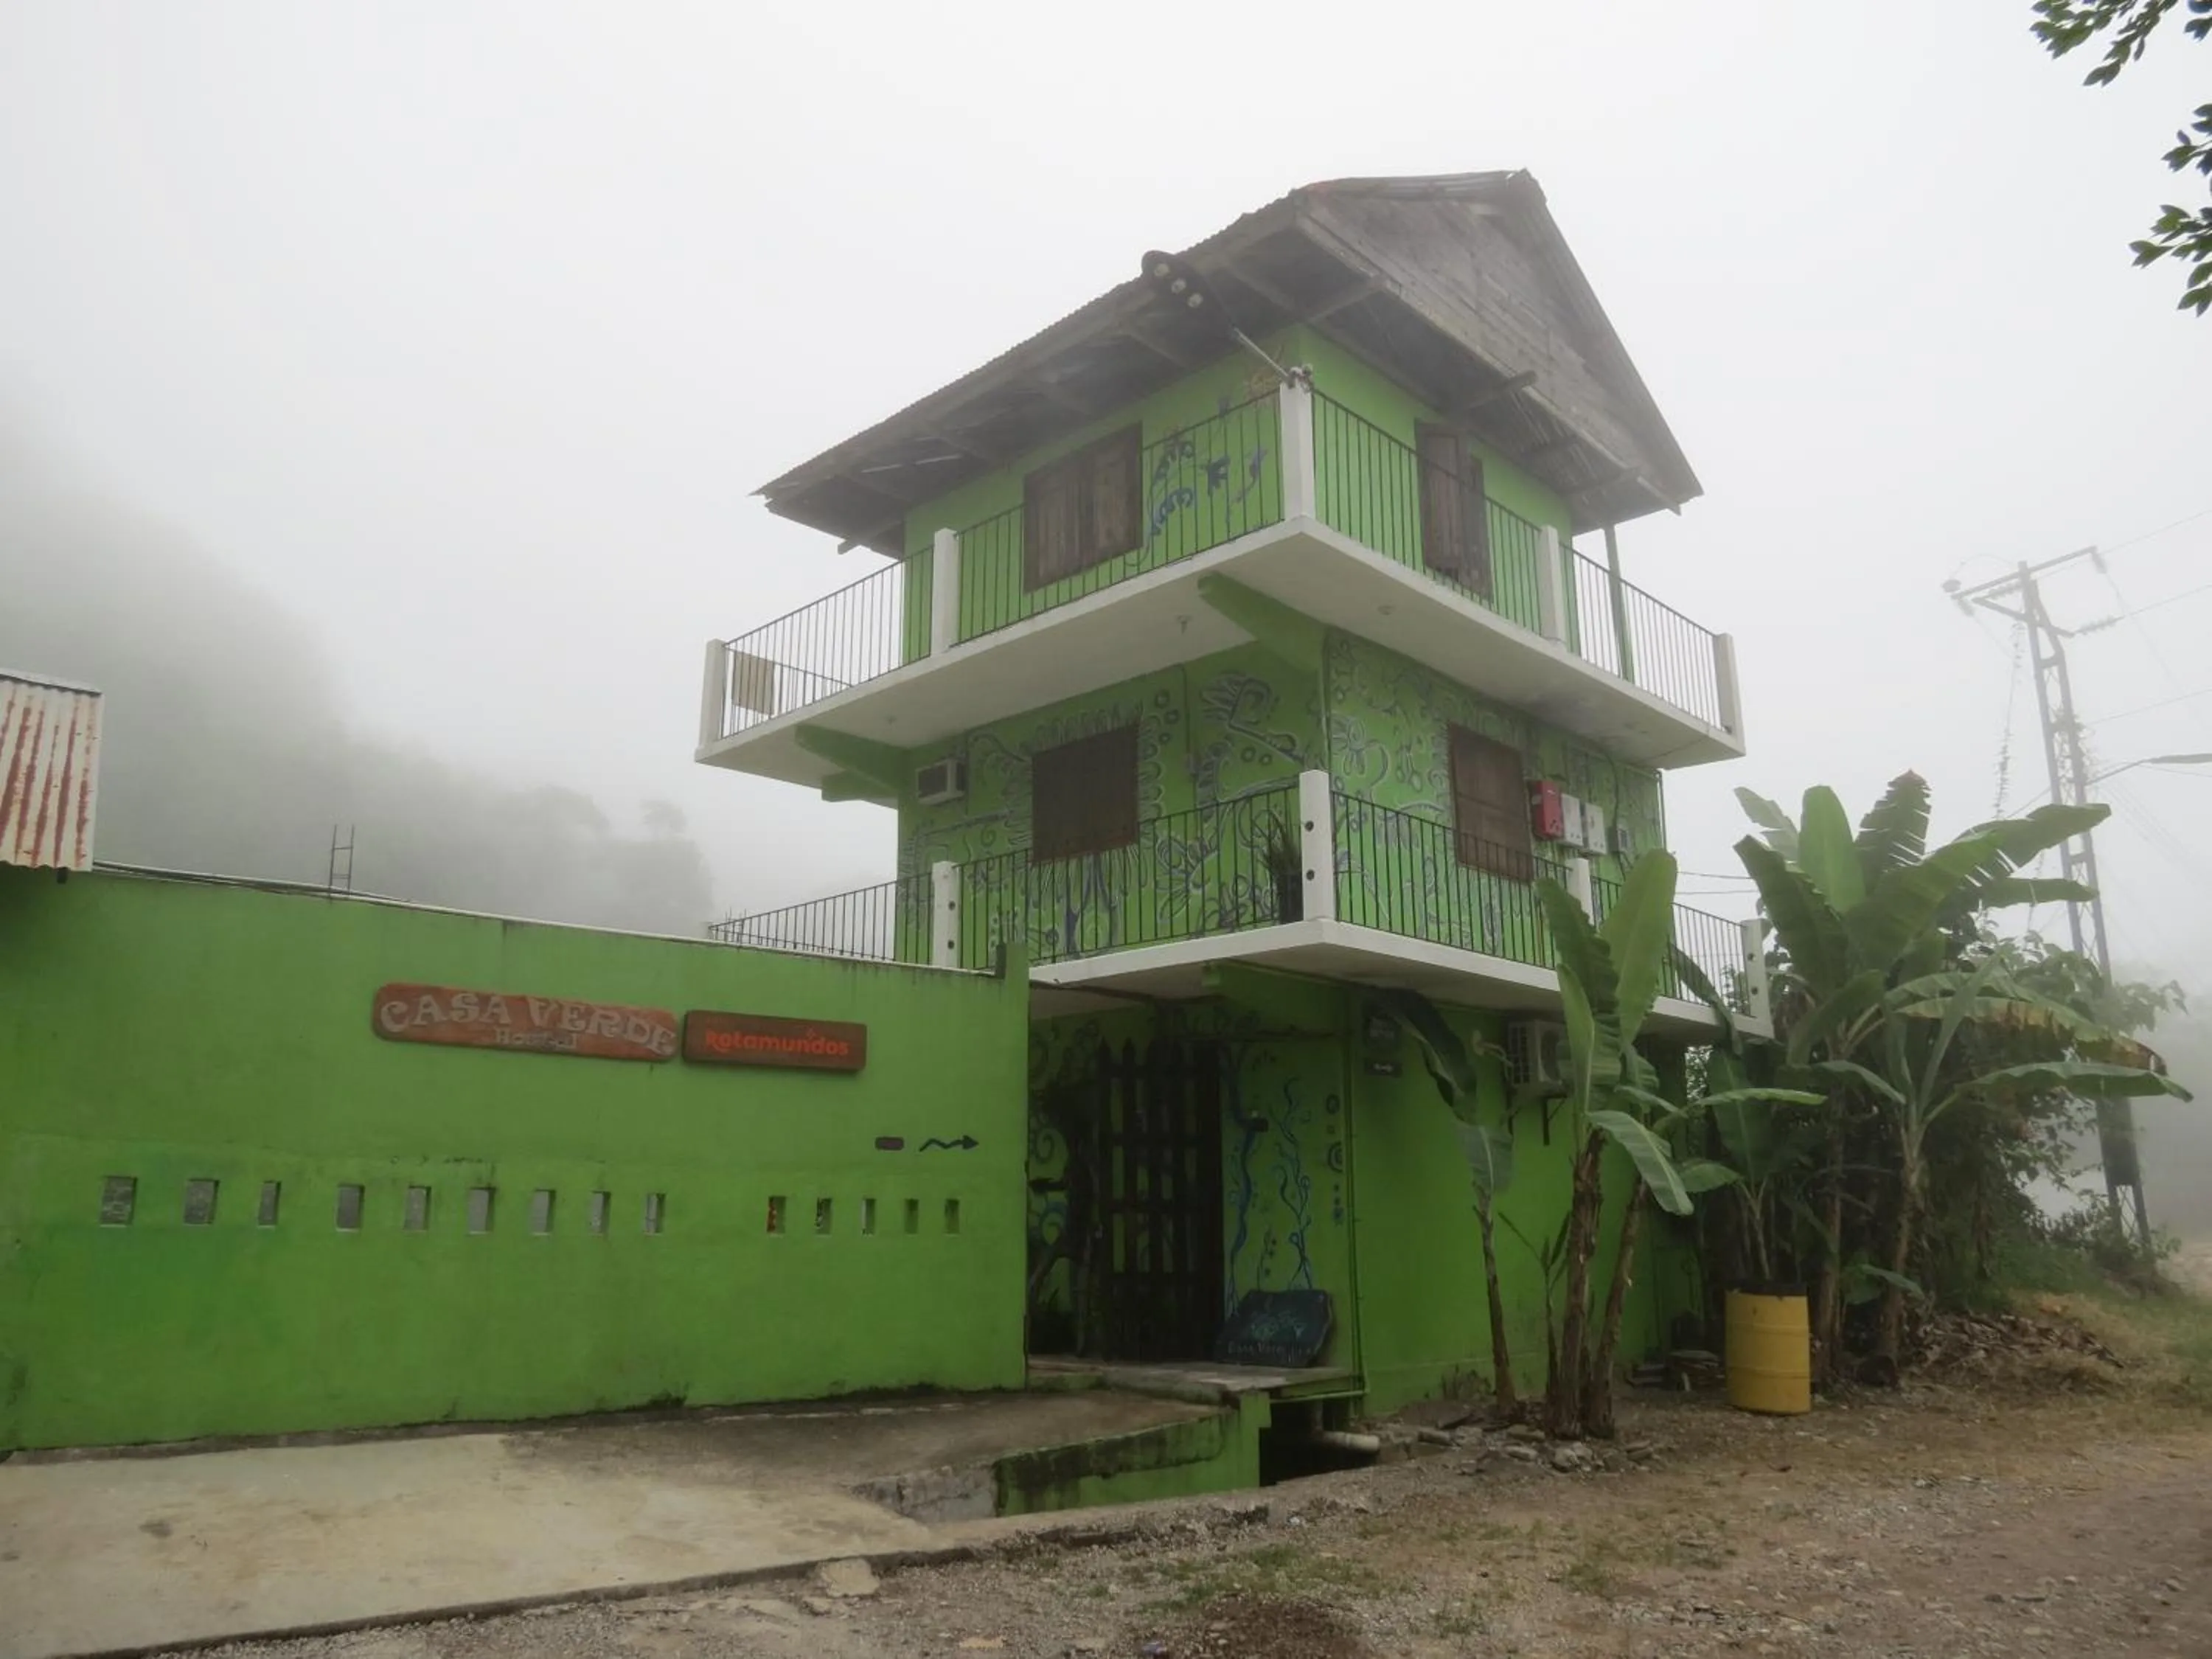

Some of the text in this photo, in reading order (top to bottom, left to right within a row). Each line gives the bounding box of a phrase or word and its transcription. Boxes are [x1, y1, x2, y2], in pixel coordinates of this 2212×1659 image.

[380, 992, 676, 1056] CASA VERDE
[706, 1028, 850, 1056] Rotamundos
